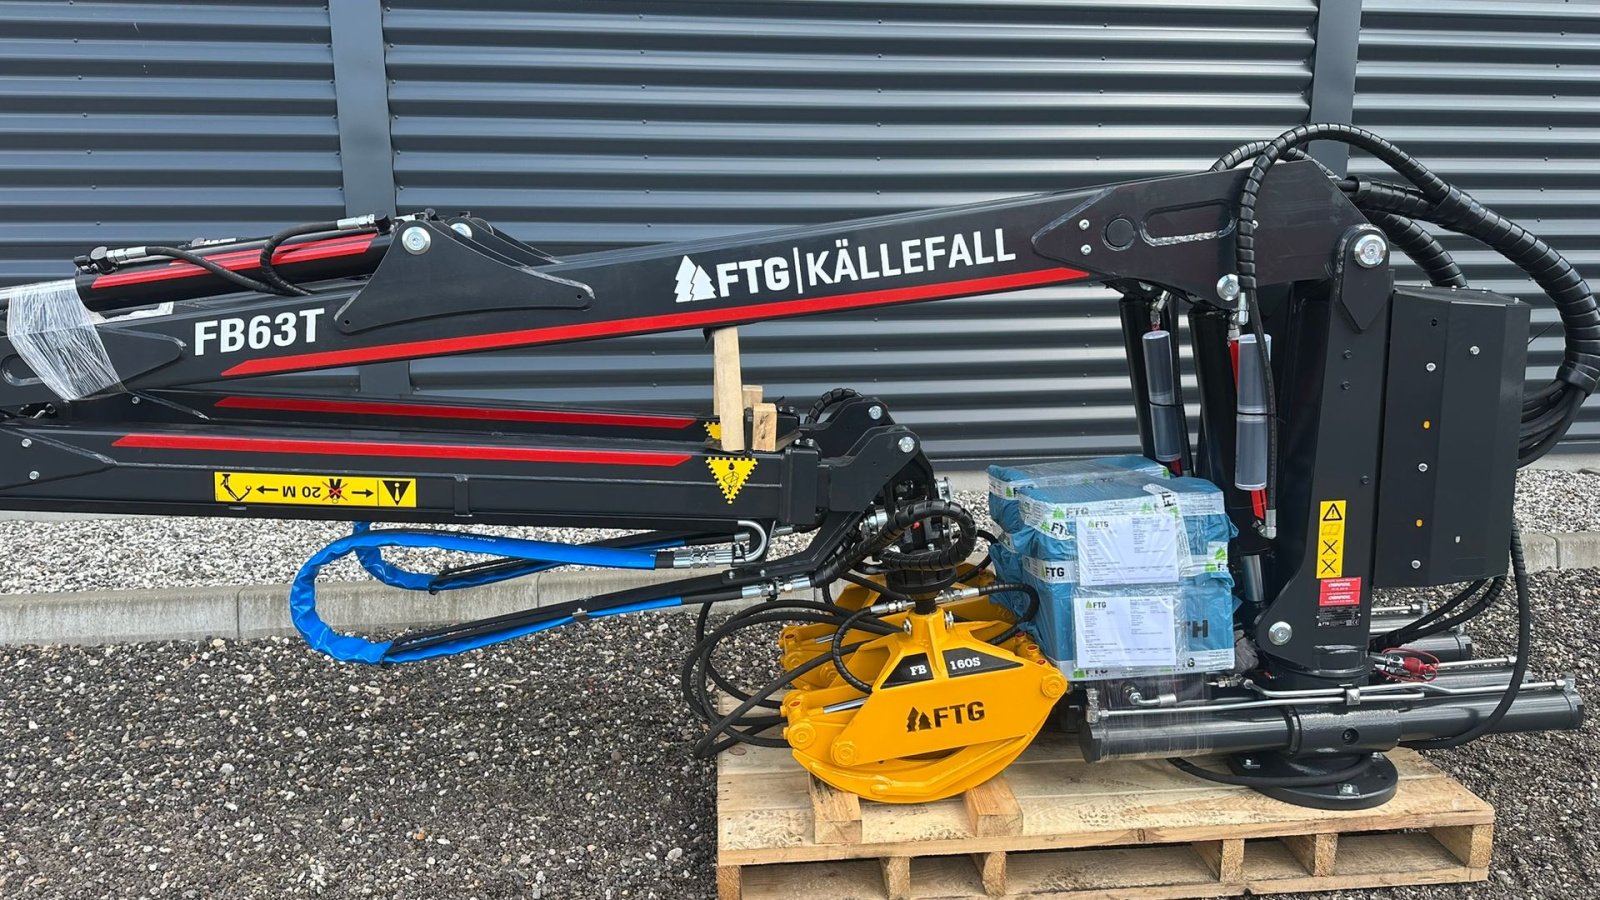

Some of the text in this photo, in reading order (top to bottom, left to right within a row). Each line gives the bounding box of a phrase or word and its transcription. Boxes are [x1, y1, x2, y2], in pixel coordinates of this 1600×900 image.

[716, 228, 1016, 297] FTG KÄLLEFALL
[194, 307, 325, 356] FB63T
[283, 485, 321, 498] 20 M
[1045, 566, 1065, 578] FTG
[1093, 601, 1107, 609] FTG
[950, 657, 981, 670] 160S
[909, 665, 927, 676] FB
[933, 701, 985, 727] FTG
